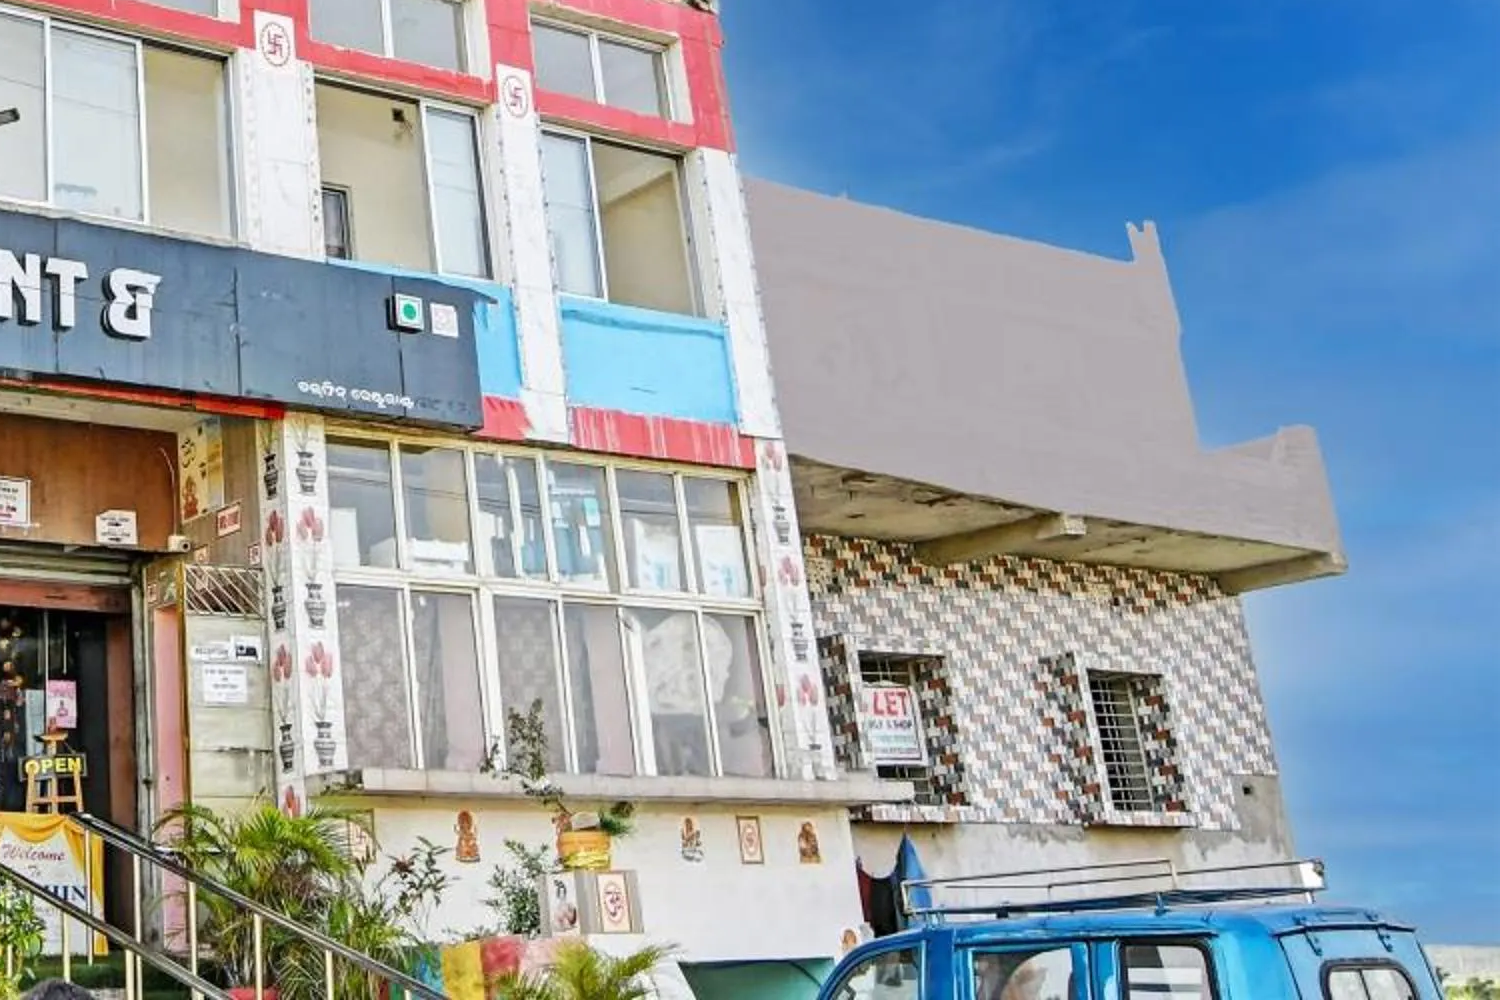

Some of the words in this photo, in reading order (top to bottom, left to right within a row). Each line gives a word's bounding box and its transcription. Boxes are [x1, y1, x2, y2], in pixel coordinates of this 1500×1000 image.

[872, 691, 908, 716] LET
[24, 756, 82, 775] OPEN
[0, 842, 66, 861] Welcome
